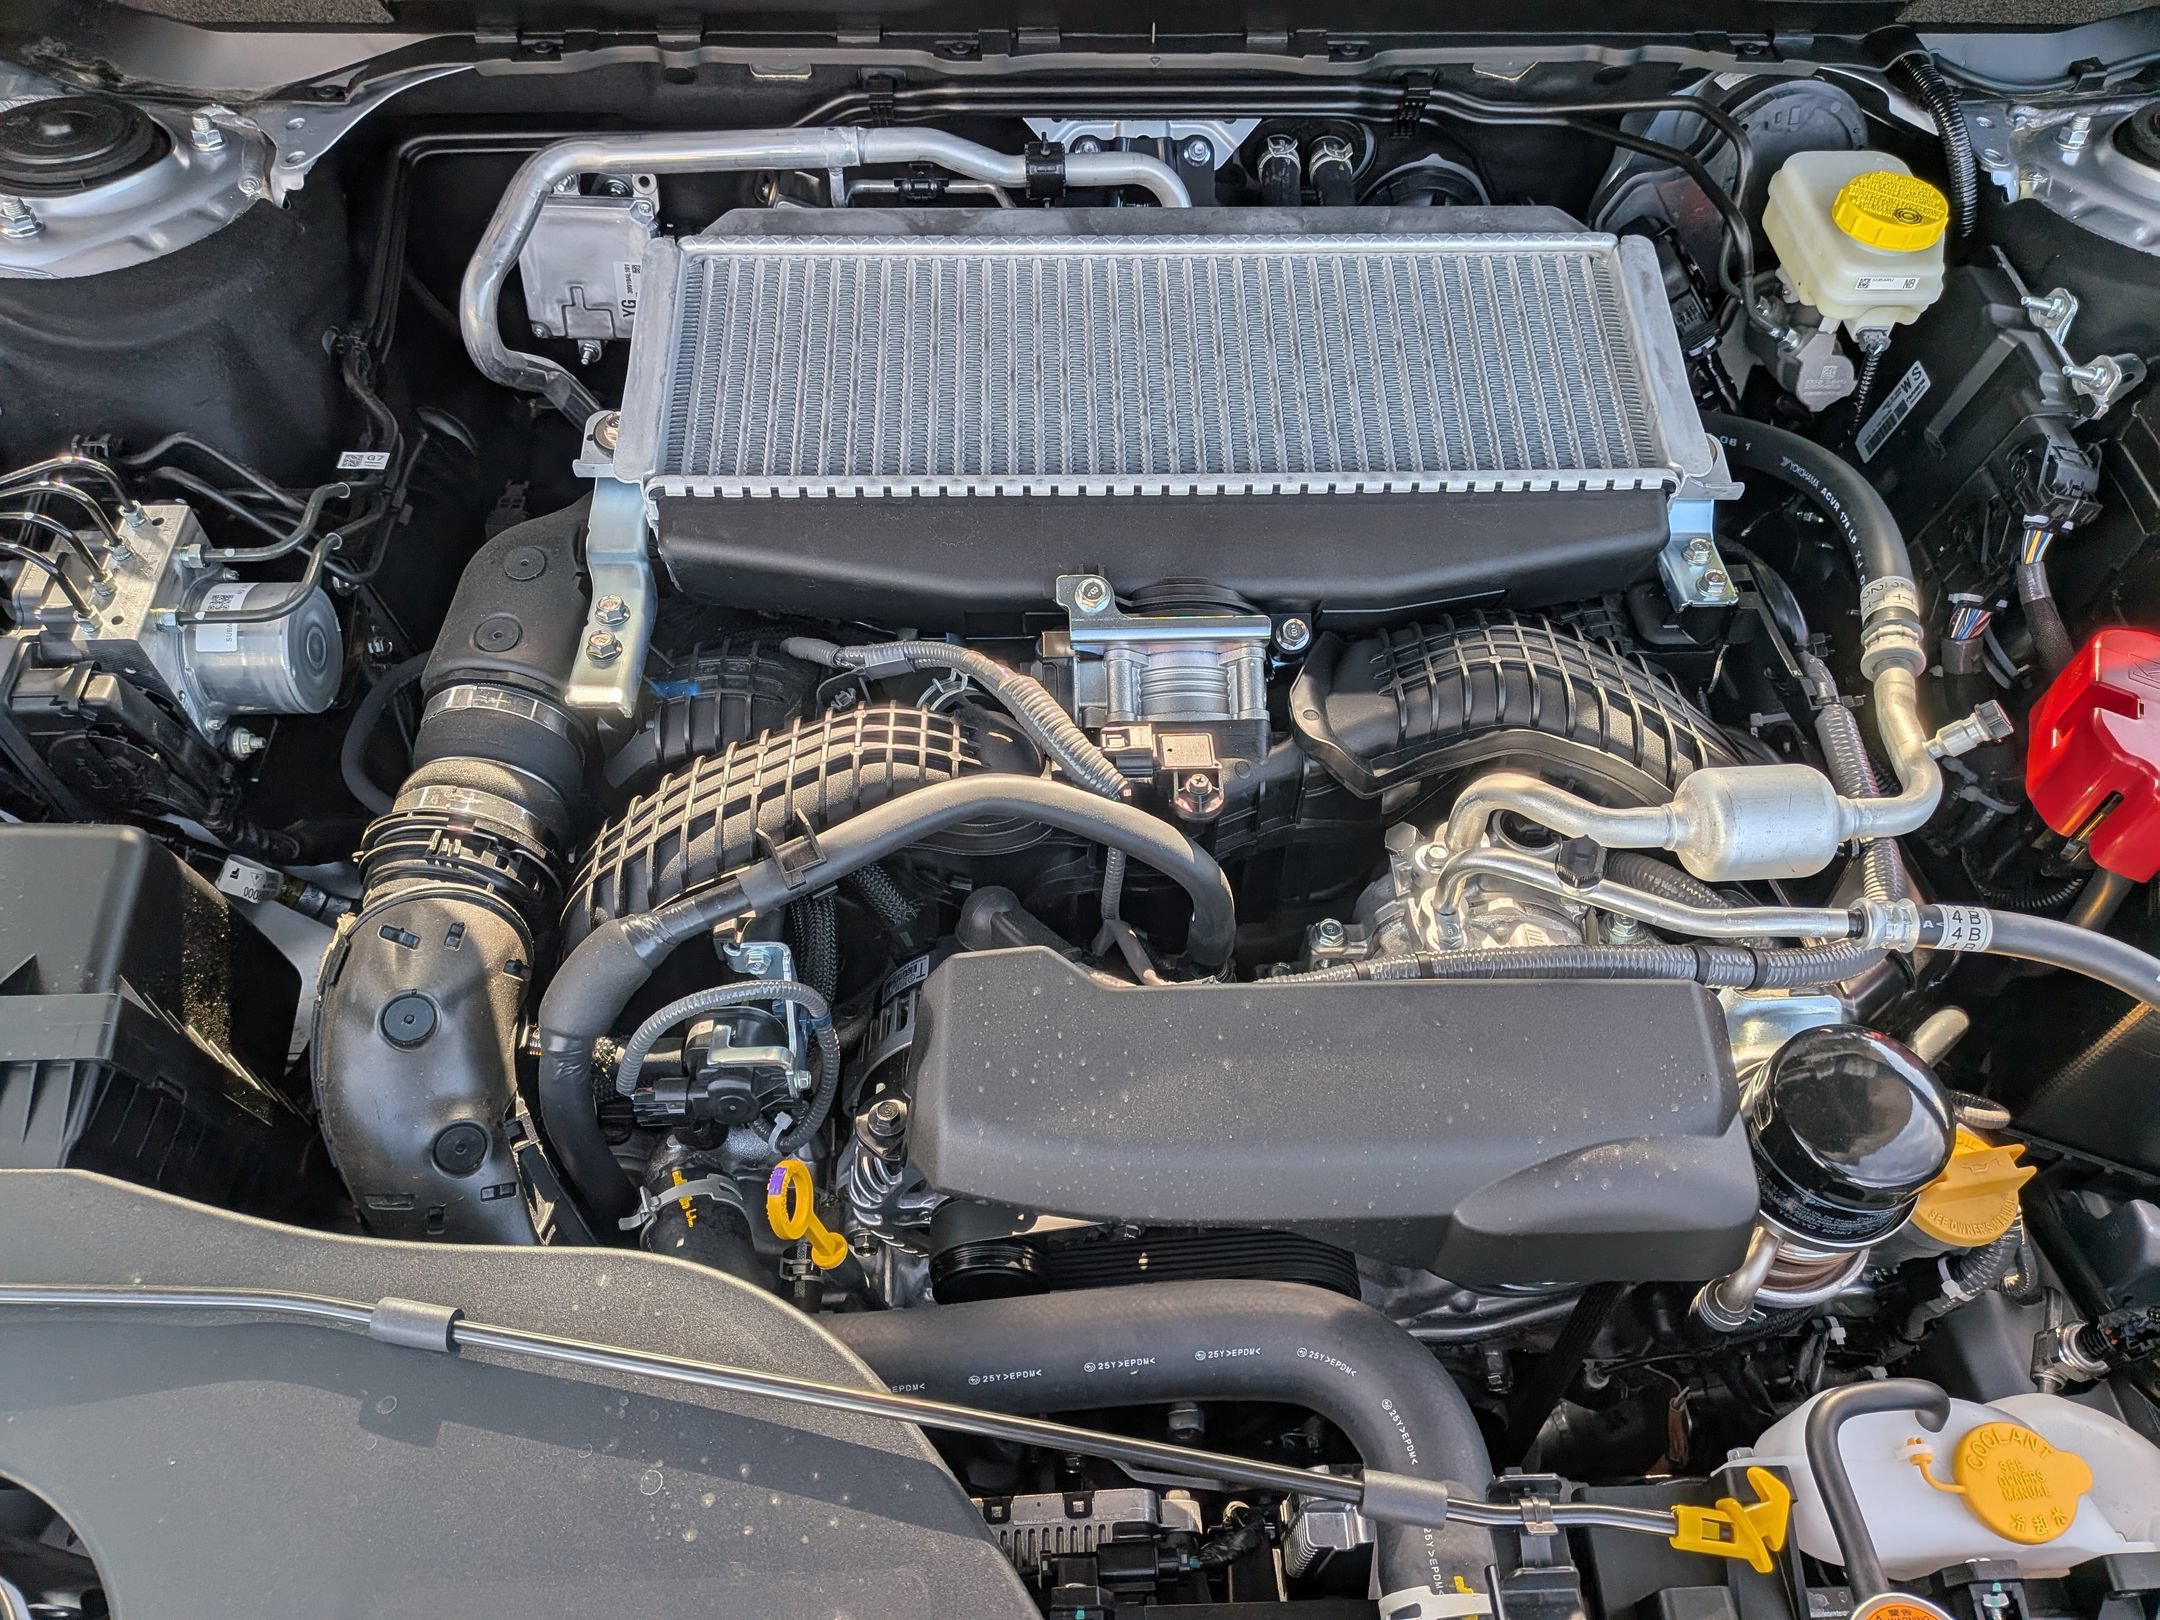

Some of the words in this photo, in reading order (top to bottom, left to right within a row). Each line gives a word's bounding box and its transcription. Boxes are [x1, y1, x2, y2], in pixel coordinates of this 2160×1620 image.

[1903, 279, 1916, 288] NB
[621, 300, 636, 317] YG
[1790, 463, 1819, 488] YOKOHAMA
[1821, 487, 1840, 512] ACVR
[1777, 1207, 1817, 1230] TOKYO
[1928, 1209, 1950, 1228] SEE
[1966, 1427, 2052, 1469] COOLANT
[1998, 1459, 2024, 1474] SEE
[1997, 1471, 2045, 1489] OWNERS
[2001, 1485, 2052, 1503] MANUAL
